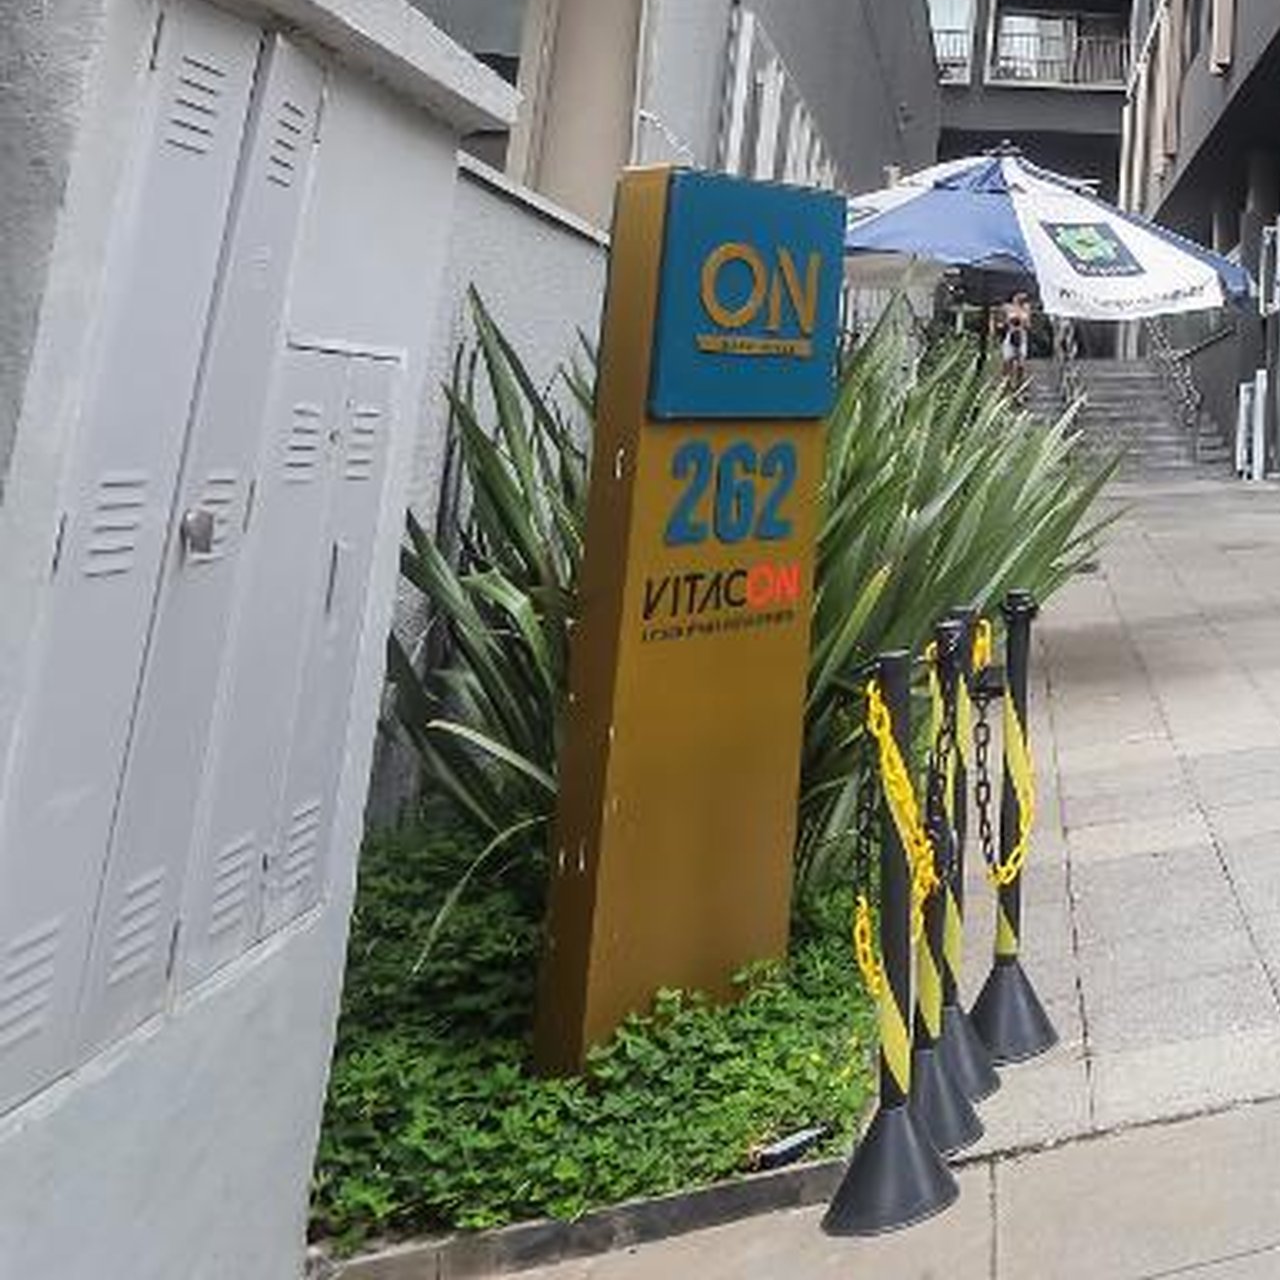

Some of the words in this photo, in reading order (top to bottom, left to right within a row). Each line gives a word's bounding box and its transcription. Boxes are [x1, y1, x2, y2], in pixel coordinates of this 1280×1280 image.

[701, 242, 822, 335] ON
[664, 438, 798, 547] 262
[642, 559, 801, 621] VITACON
